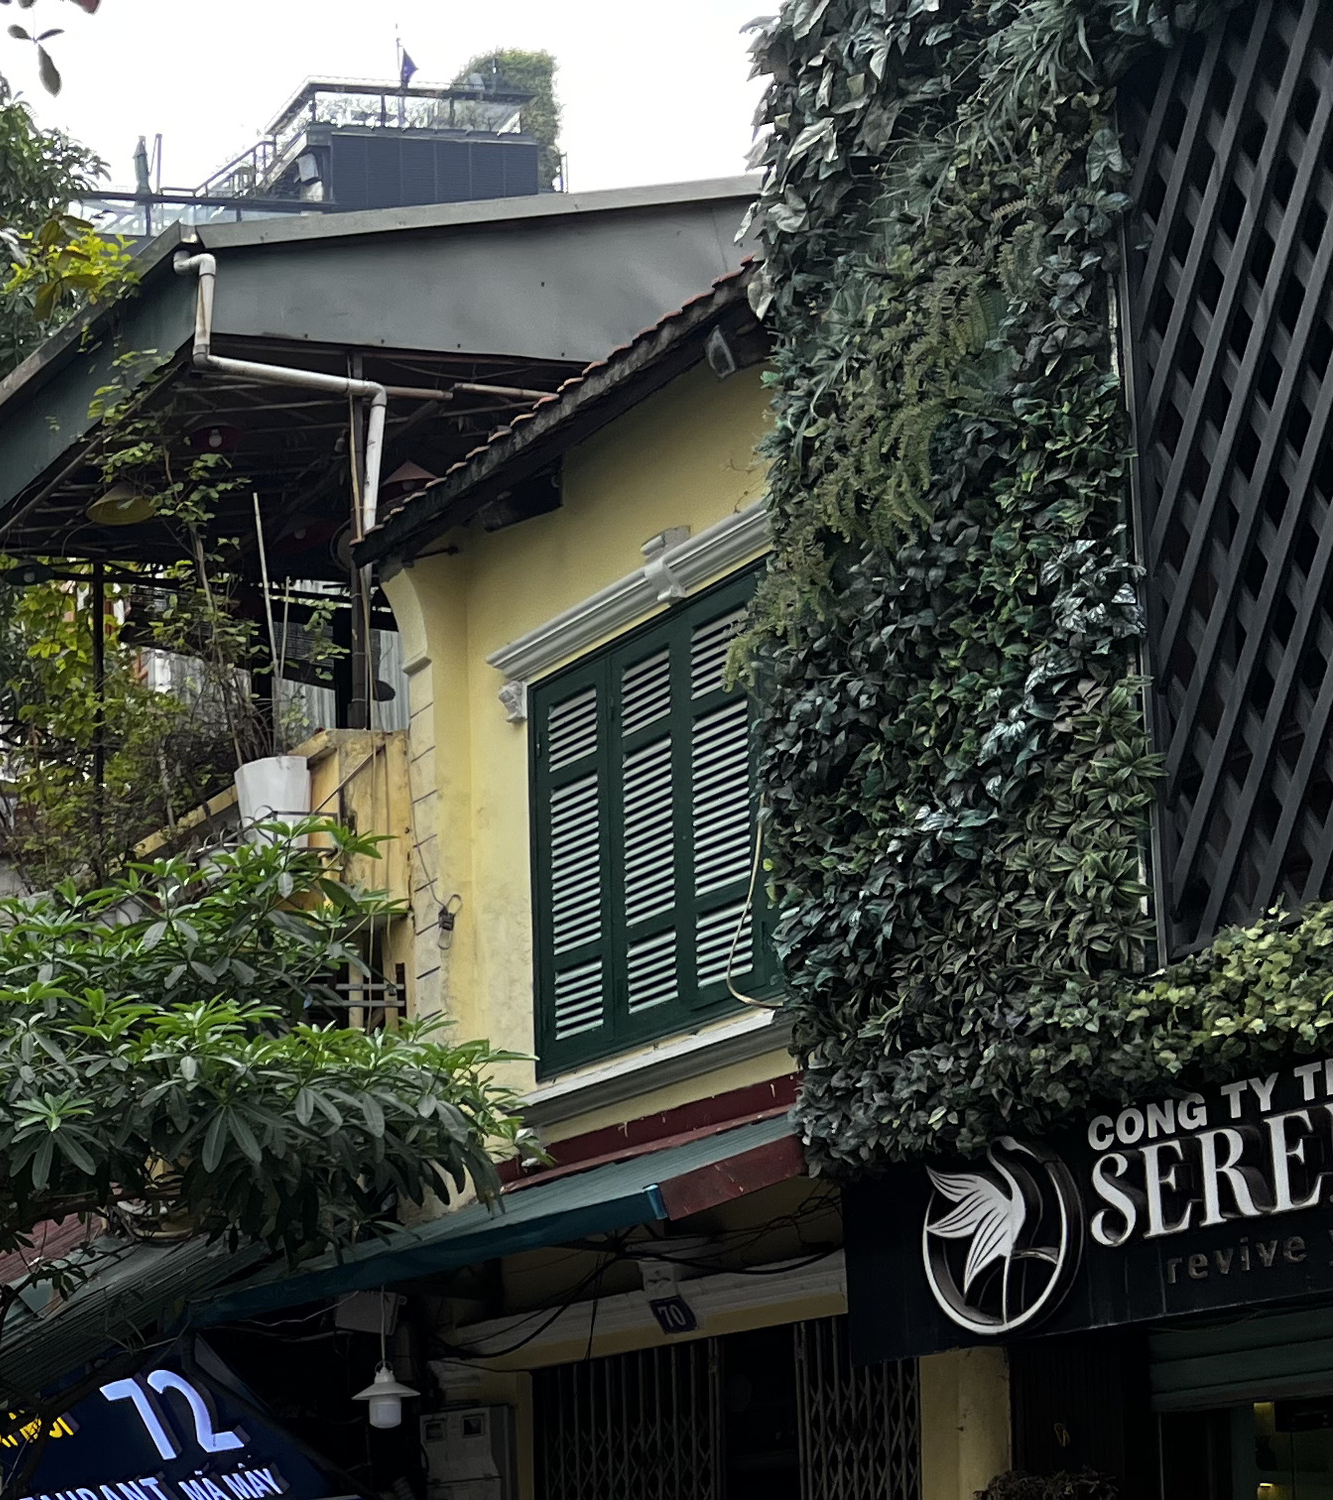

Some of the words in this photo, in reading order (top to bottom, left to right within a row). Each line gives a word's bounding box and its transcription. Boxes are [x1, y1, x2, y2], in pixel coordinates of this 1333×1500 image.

[1221, 1072, 1279, 1119] TY
[1294, 1058, 1333, 1101] T
[1090, 1102, 1333, 1247] SERE
[1167, 1236, 1308, 1285] revive
[656, 1304, 687, 1327] 70
[100, 1369, 244, 1460] 72
